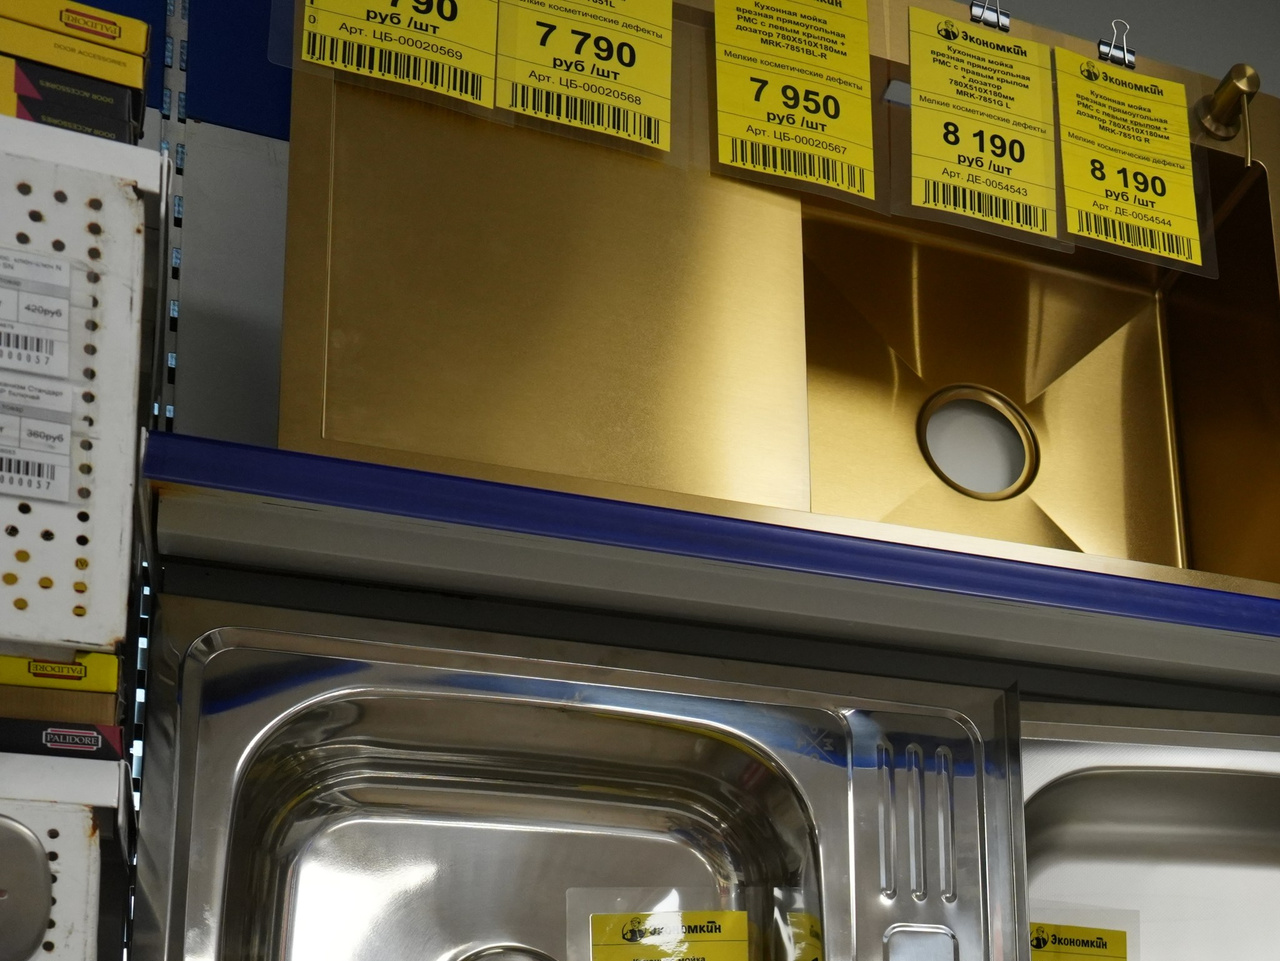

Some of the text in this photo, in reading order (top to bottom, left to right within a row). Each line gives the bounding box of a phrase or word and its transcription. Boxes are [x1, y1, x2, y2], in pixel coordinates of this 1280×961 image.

[366, 9, 440, 34] руб /шт
[549, 3, 663, 39] косметические дефекты
[754, 1, 797, 17] Кухонная
[799, 13, 827, 24] мойка
[339, 22, 463, 60] Арт. ЦБ-00020569
[536, 21, 636, 67] 7 790
[553, 57, 620, 81] руб /шт
[723, 49, 862, 90] Мелкие косметические дефекты
[528, 70, 642, 105] Арт. ЦБ-00020568
[749, 76, 840, 119] 7 950
[766, 111, 827, 132] руб /шт
[745, 124, 847, 154] Арт. ЦБ-00020567
[942, 121, 1024, 163] 8 190
[957, 153, 1012, 175] руб /шт
[1090, 158, 1166, 196] 8 190
[941, 167, 1027, 196] Арт. ДЕ-0054543
[1104, 188, 1155, 208] руб /шт
[1092, 200, 1171, 227] Арт. ДЕ-0054544
[32, 664, 83, 674] PALIDORE
[47, 734, 98, 745] PALIDORE
